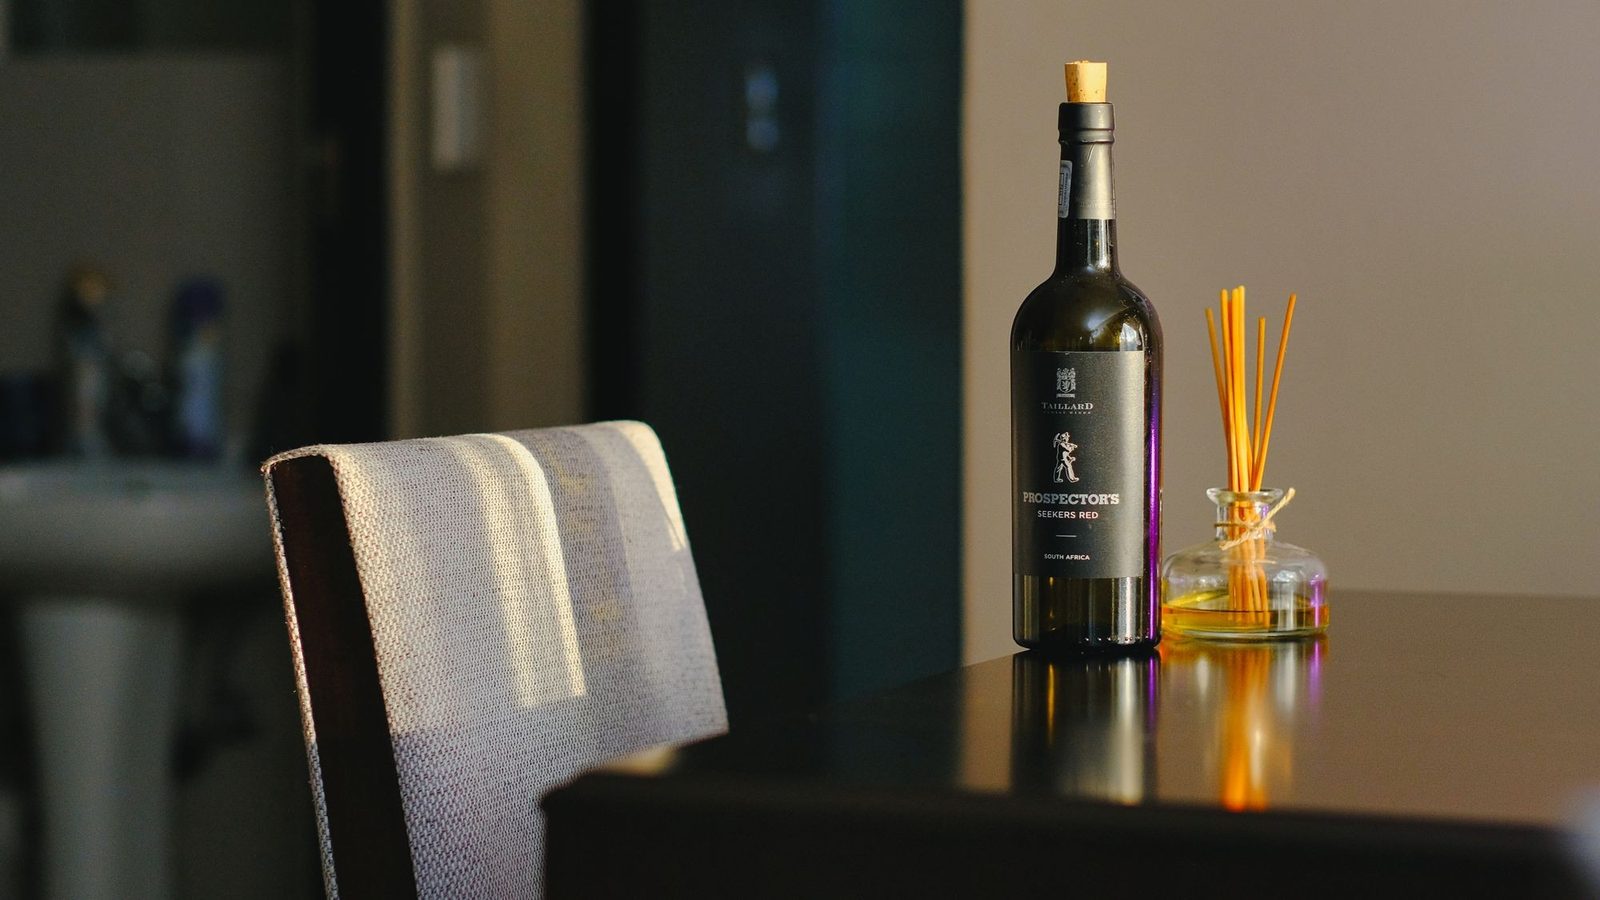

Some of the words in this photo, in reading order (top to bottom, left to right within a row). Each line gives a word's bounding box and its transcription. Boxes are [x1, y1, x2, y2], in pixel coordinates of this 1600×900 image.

[1041, 401, 1094, 410] TAILLARD
[1023, 491, 1120, 505] PROSPECTOR'S
[1037, 510, 1076, 519] SEEKERS
[1079, 511, 1099, 519] RED
